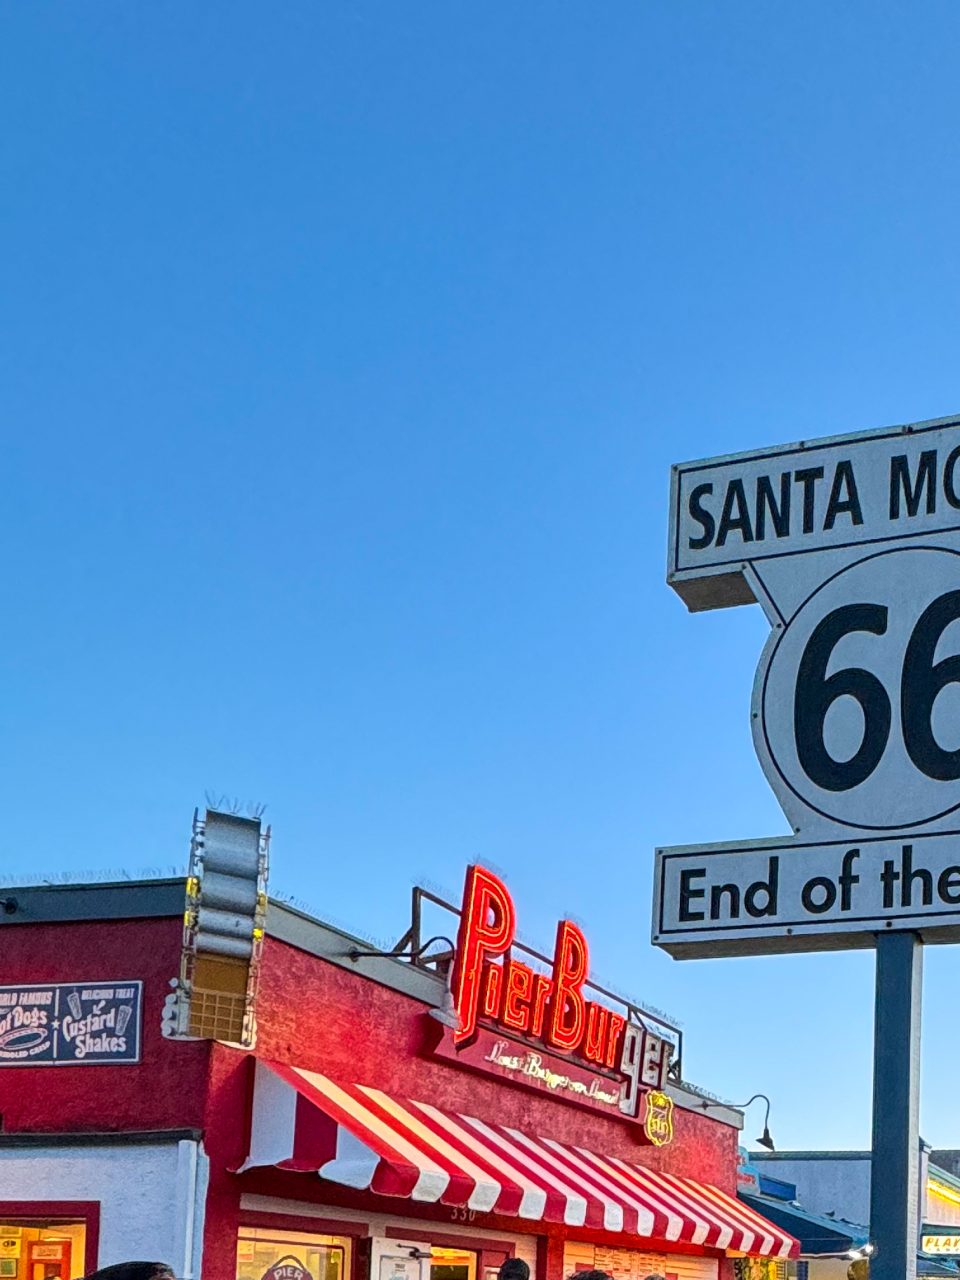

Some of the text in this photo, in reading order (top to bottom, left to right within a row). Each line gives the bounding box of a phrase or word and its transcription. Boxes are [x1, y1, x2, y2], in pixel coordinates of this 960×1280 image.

[688, 459, 864, 550] SANTA
[678, 855, 780, 922] End
[800, 848, 860, 914] of
[19, 991, 53, 1006] FAMOUS
[115, 987, 135, 999] TREAT
[11, 1005, 48, 1028] Dogs
[62, 1007, 116, 1042] Custard
[74, 1032, 127, 1058] Shakes
[273, 1267, 304, 1280] PIER
